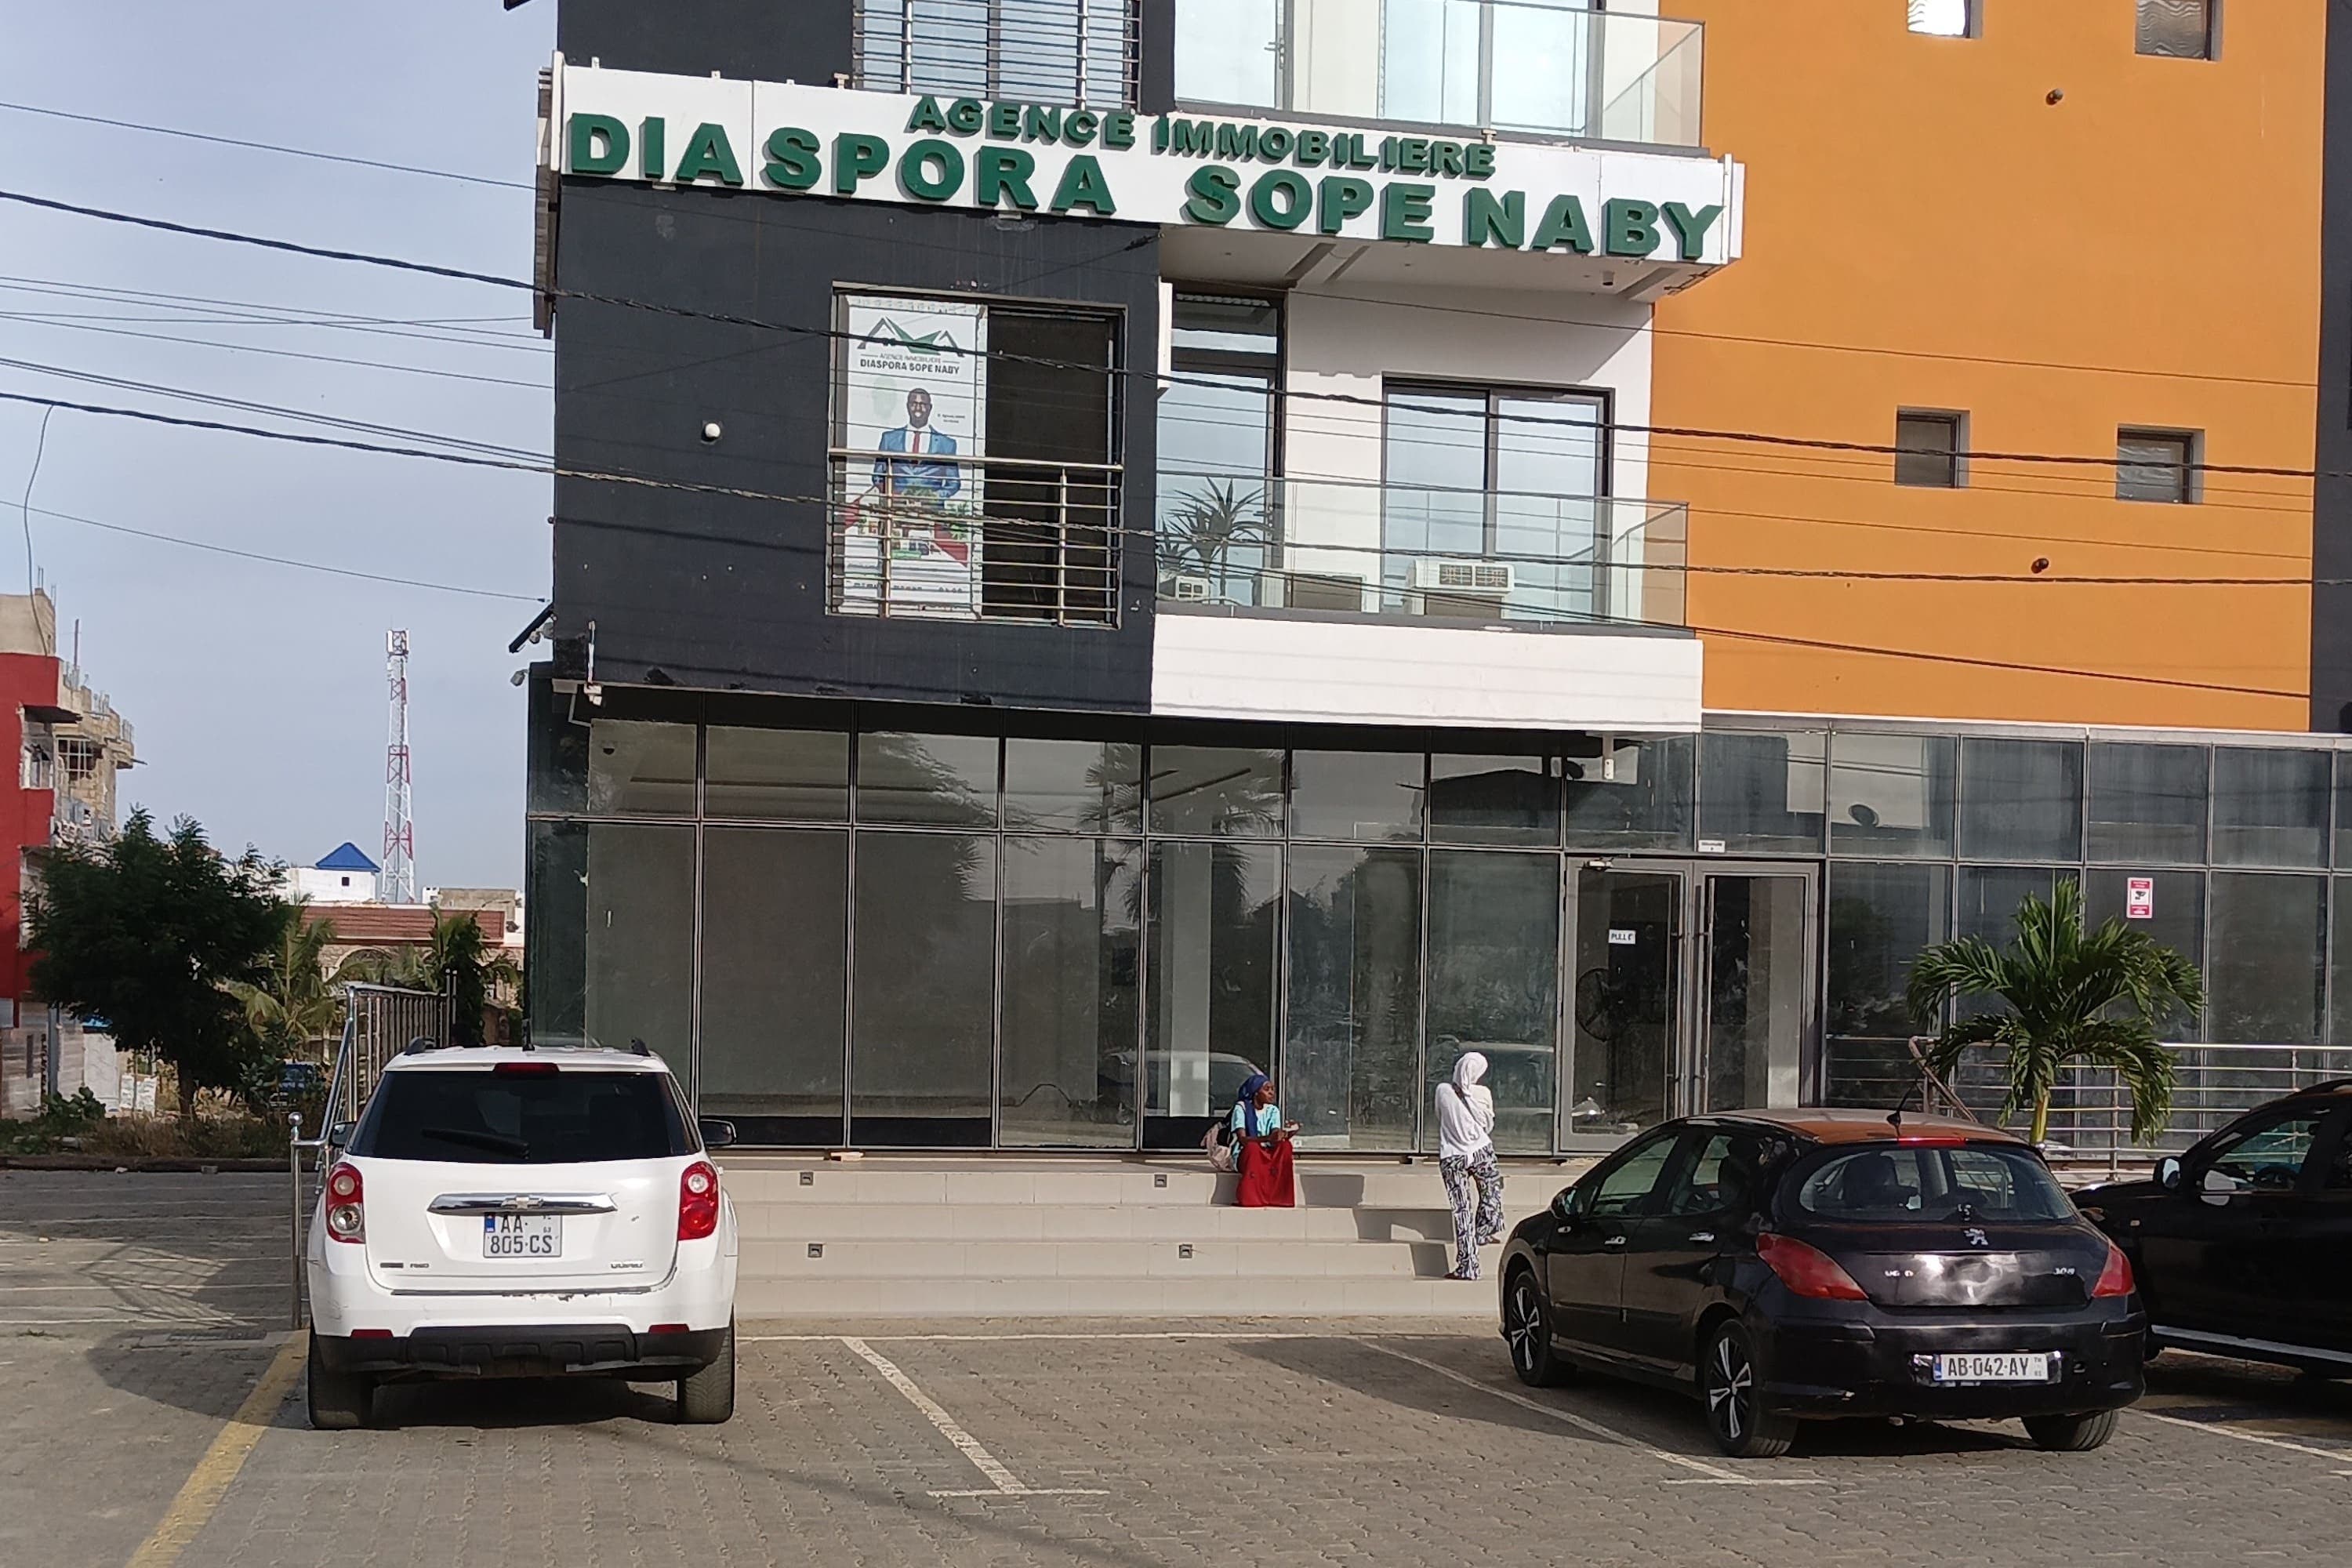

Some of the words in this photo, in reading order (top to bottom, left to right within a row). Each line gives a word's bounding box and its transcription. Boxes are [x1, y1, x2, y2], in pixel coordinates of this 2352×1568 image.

[906, 95, 1136, 147] AGENCE
[1152, 116, 1497, 180] IMMOBILIERE
[568, 112, 1117, 216] DIASPORA
[1181, 164, 1436, 244] SOPE
[1464, 187, 1724, 260] NABY
[860, 358, 907, 371] DIASPORA
[909, 363, 933, 372] SOPE
[935, 365, 960, 374] NABY
